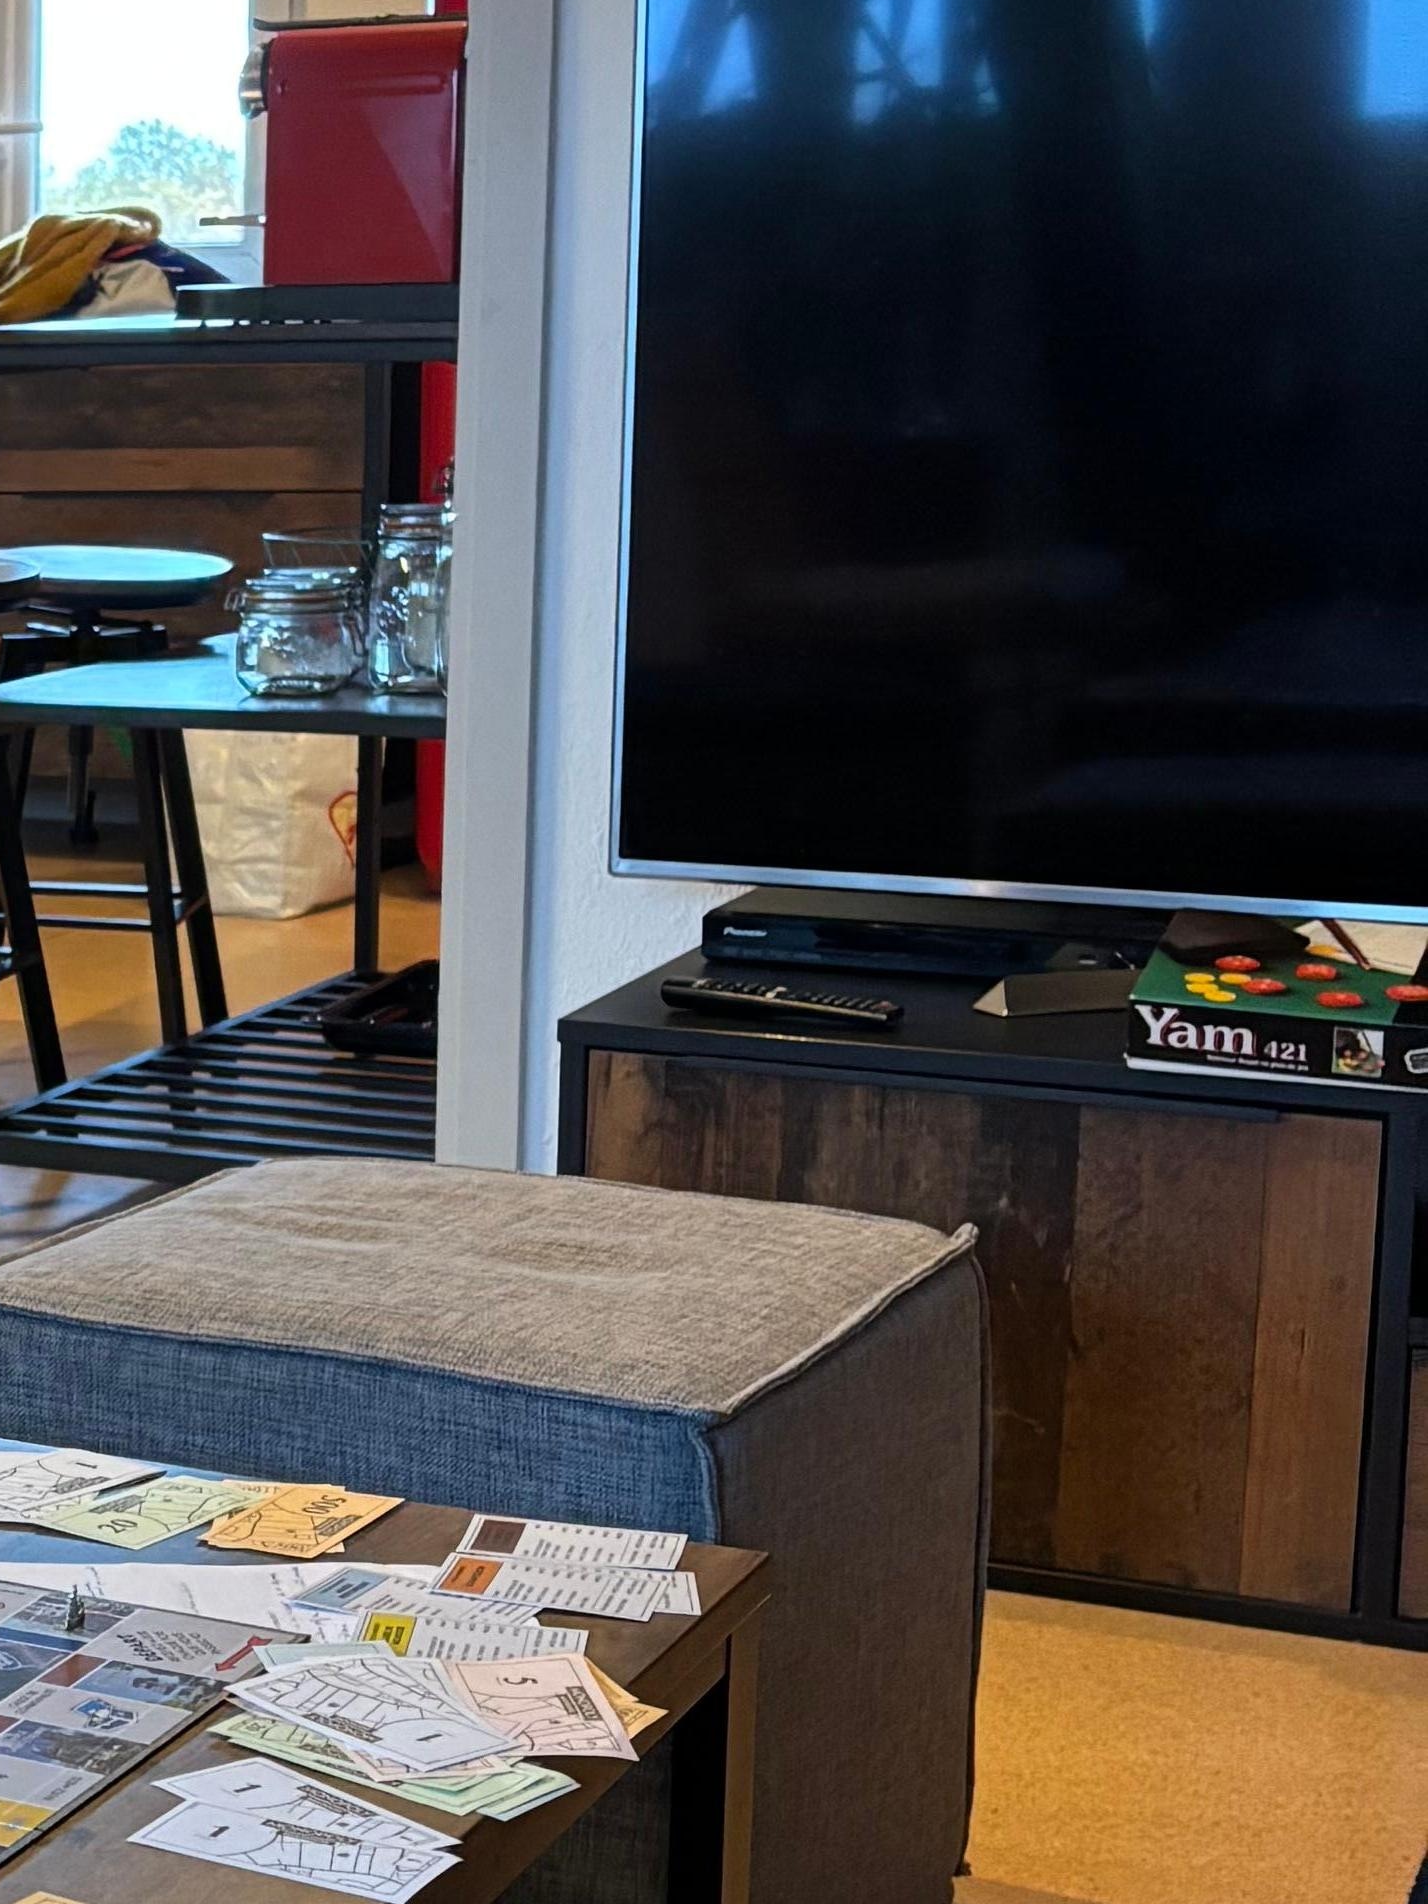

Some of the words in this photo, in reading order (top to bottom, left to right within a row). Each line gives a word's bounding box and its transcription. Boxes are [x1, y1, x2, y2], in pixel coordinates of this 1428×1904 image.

[1134, 1004, 1257, 1057] Yam
[1263, 1040, 1308, 1063] 421
[301, 1494, 347, 1516] 500
[98, 1519, 138, 1536] 20
